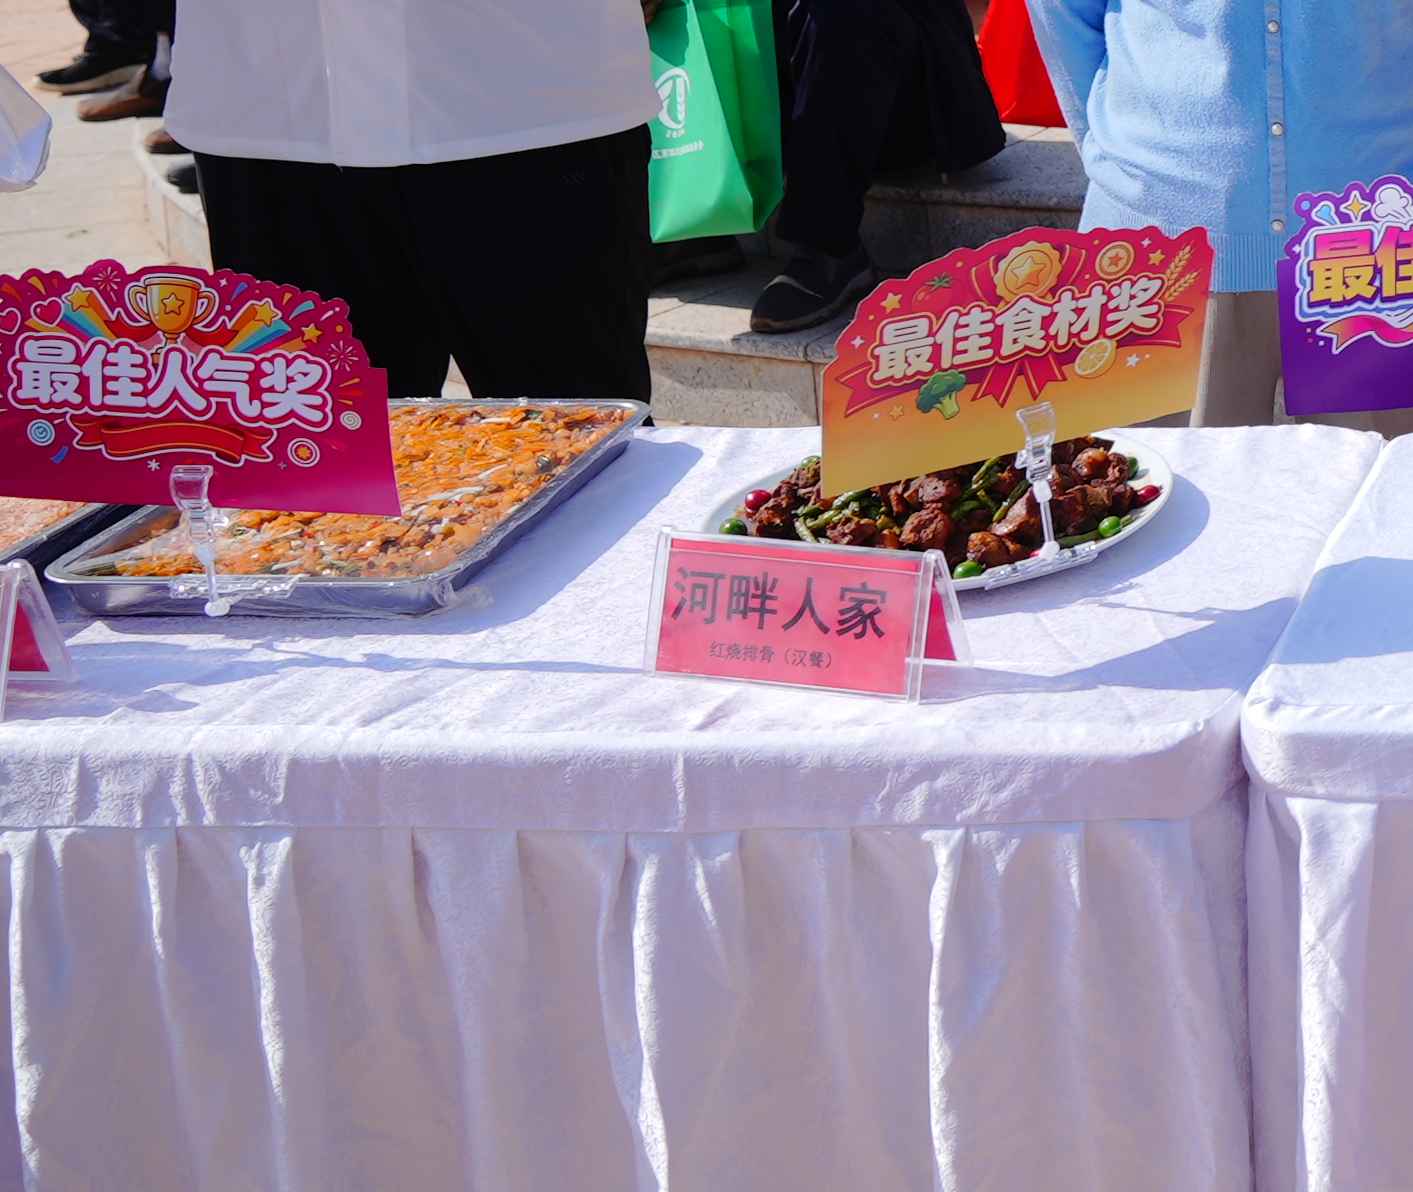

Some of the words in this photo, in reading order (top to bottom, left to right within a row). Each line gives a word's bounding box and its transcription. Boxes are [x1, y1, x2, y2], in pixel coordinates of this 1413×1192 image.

[871, 275, 1166, 383] 最佳食材奖
[16, 337, 326, 424] 最佳人气奖
[670, 566, 889, 640] 河畔人家
